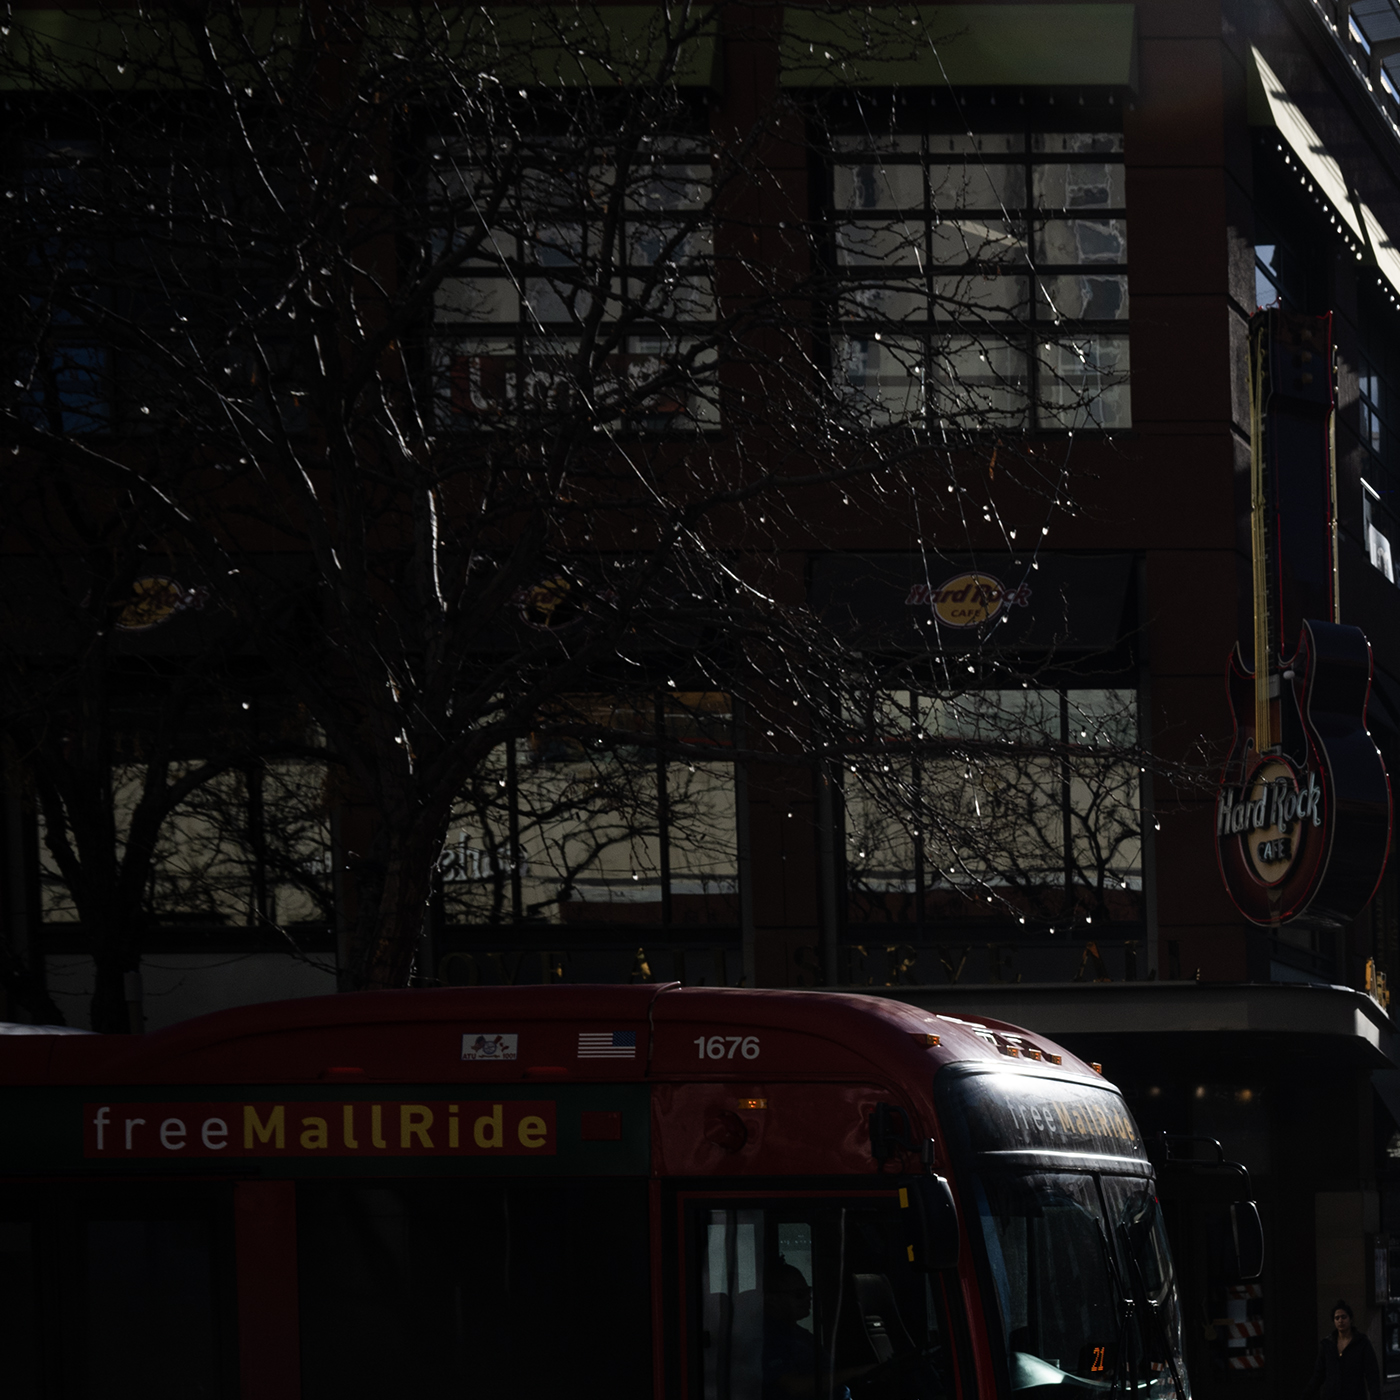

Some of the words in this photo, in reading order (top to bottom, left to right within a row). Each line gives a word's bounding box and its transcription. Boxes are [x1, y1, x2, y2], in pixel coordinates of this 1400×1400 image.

[905, 583, 973, 606] Hard
[968, 581, 1032, 609] Rock
[950, 608, 982, 619] CAFE
[1216, 784, 1269, 837] Hard
[1269, 770, 1322, 834] Rock
[1257, 841, 1287, 862] CAFE
[437, 951, 572, 986] OVE
[693, 1035, 760, 1061] 1676
[92, 1103, 548, 1152] freeMallRide
[1090, 1346, 1106, 1372] 21
